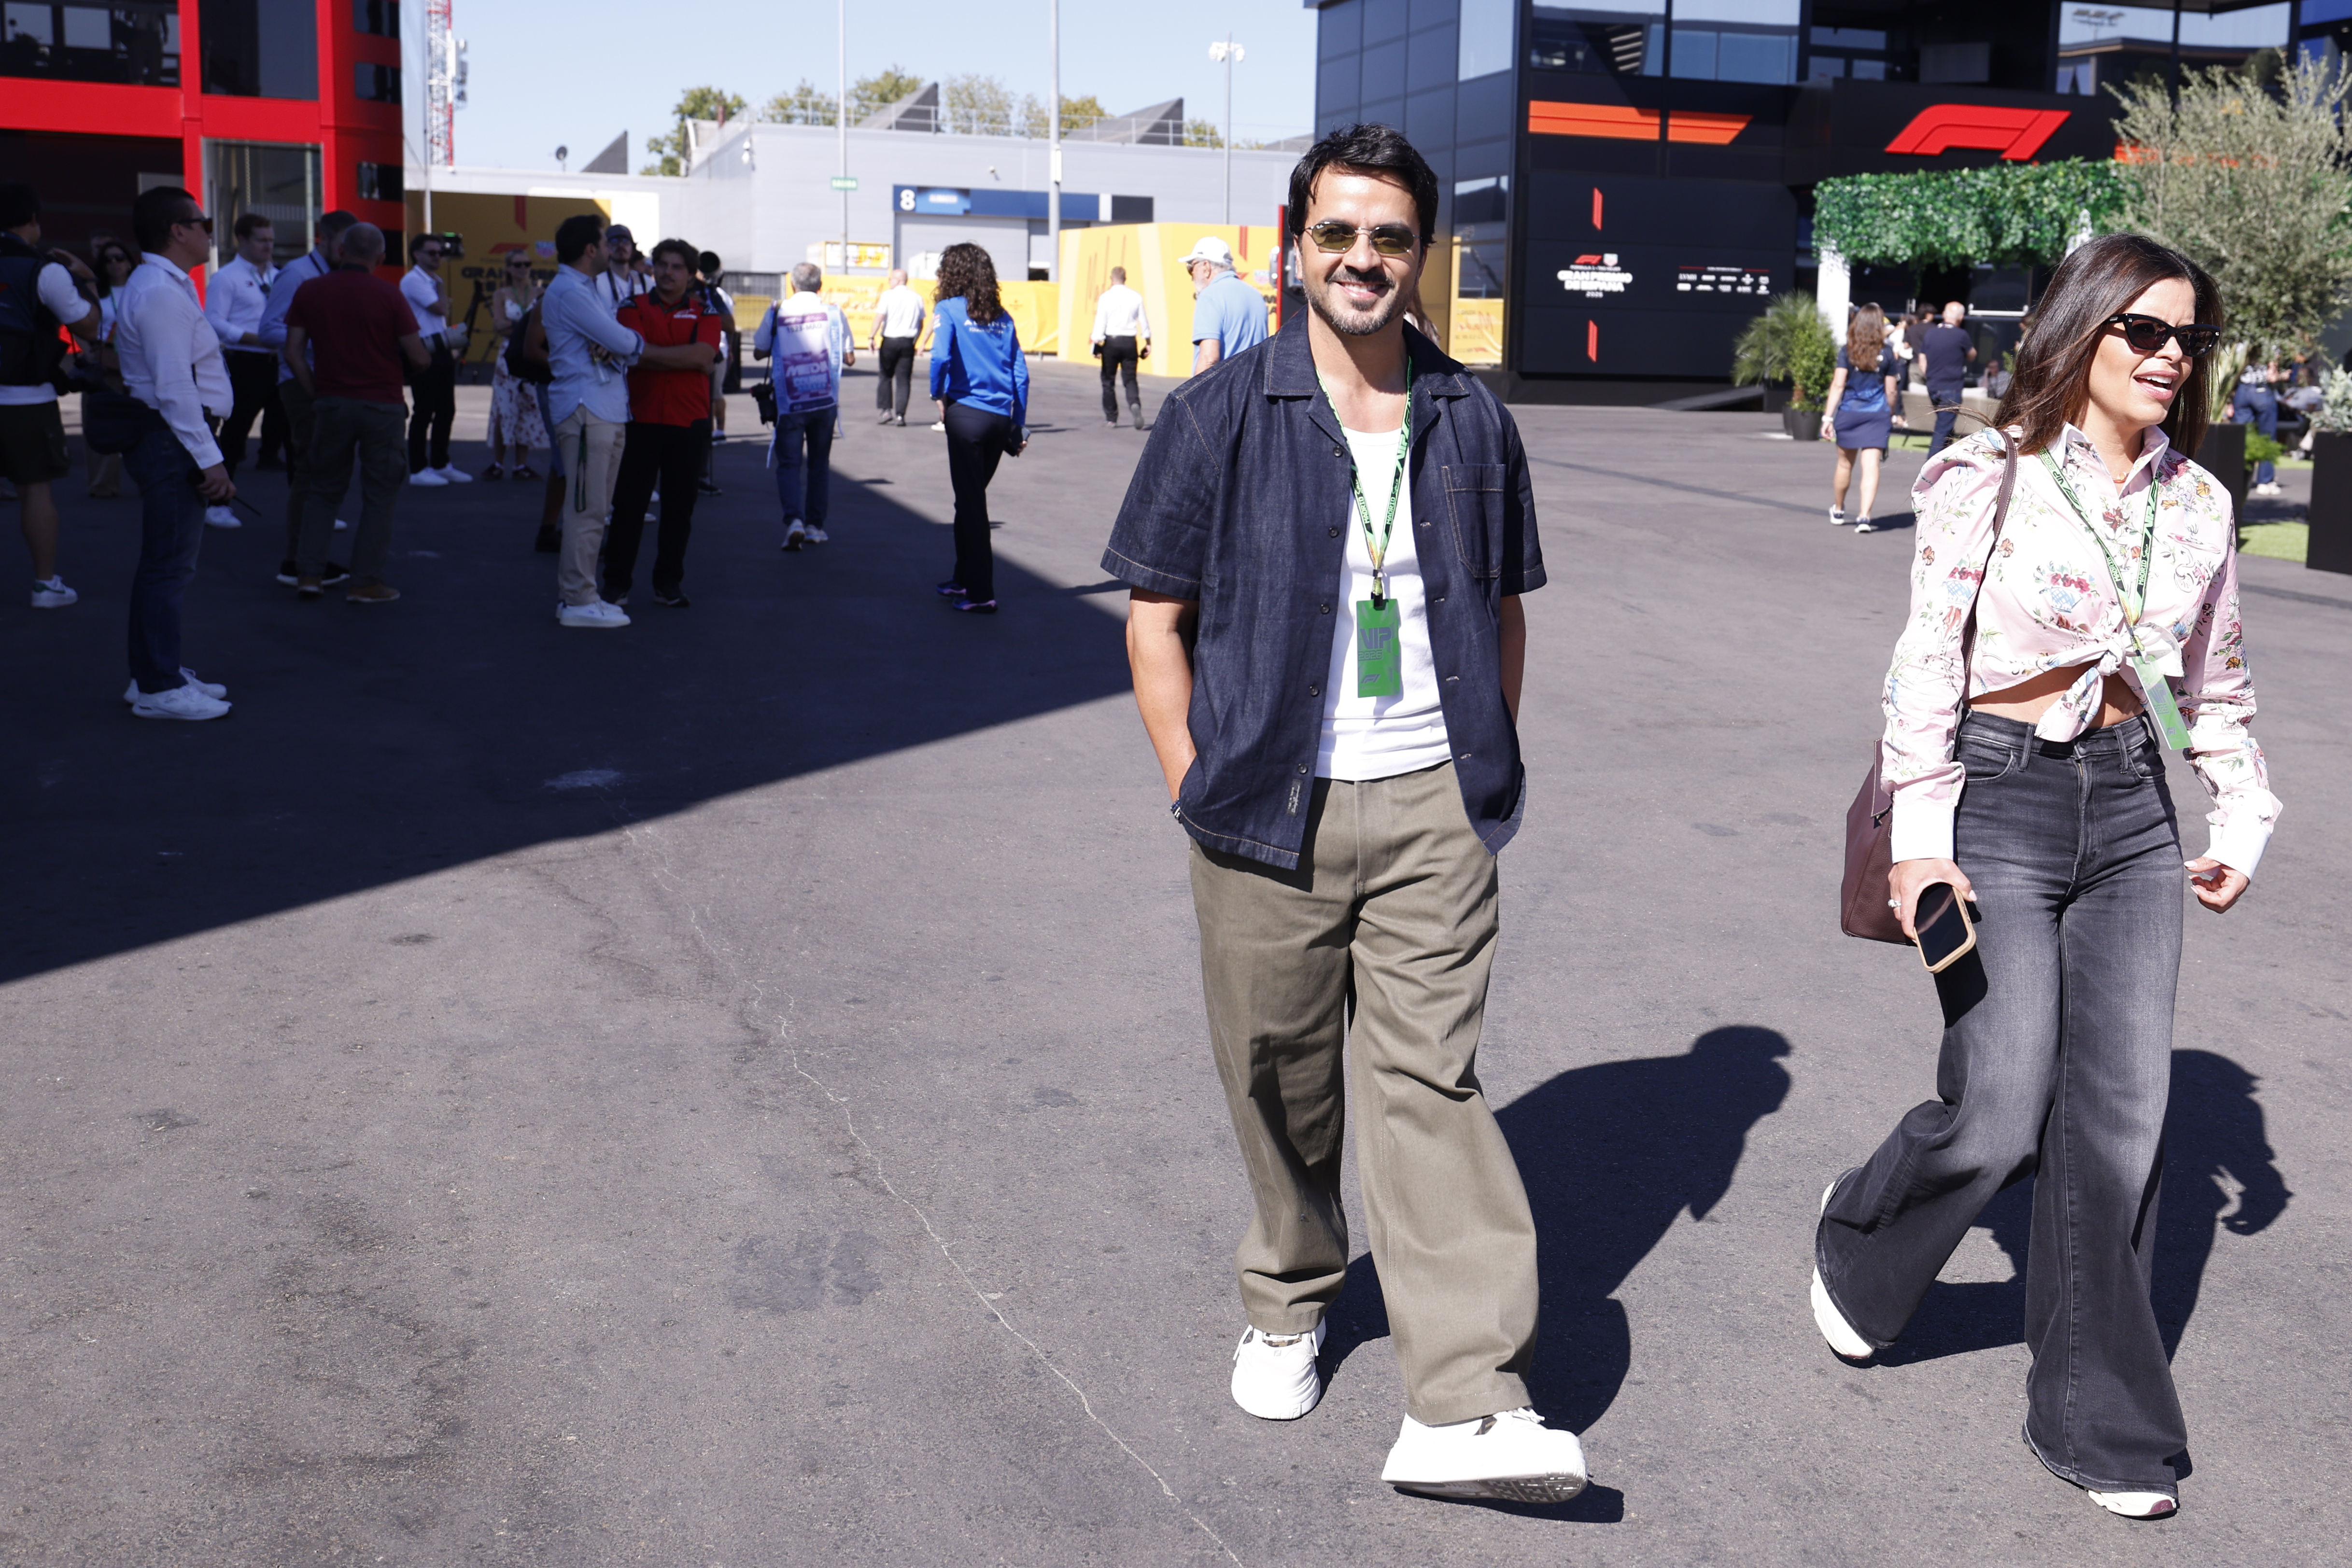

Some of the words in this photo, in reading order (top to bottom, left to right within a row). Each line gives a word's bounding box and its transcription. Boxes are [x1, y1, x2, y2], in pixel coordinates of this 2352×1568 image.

[900, 189, 915, 211] 8
[1557, 270, 1590, 281] GRAN
[1564, 280, 1580, 290] DE
[1397, 434, 1408, 460] VIP
[2053, 470, 2064, 485] VIP
[1358, 496, 1370, 524] MADRID
[1386, 497, 1396, 525] MADRID
[2144, 507, 2155, 528] VIP
[2138, 560, 2147, 586] MADRID
[1360, 627, 1393, 649] VIP
